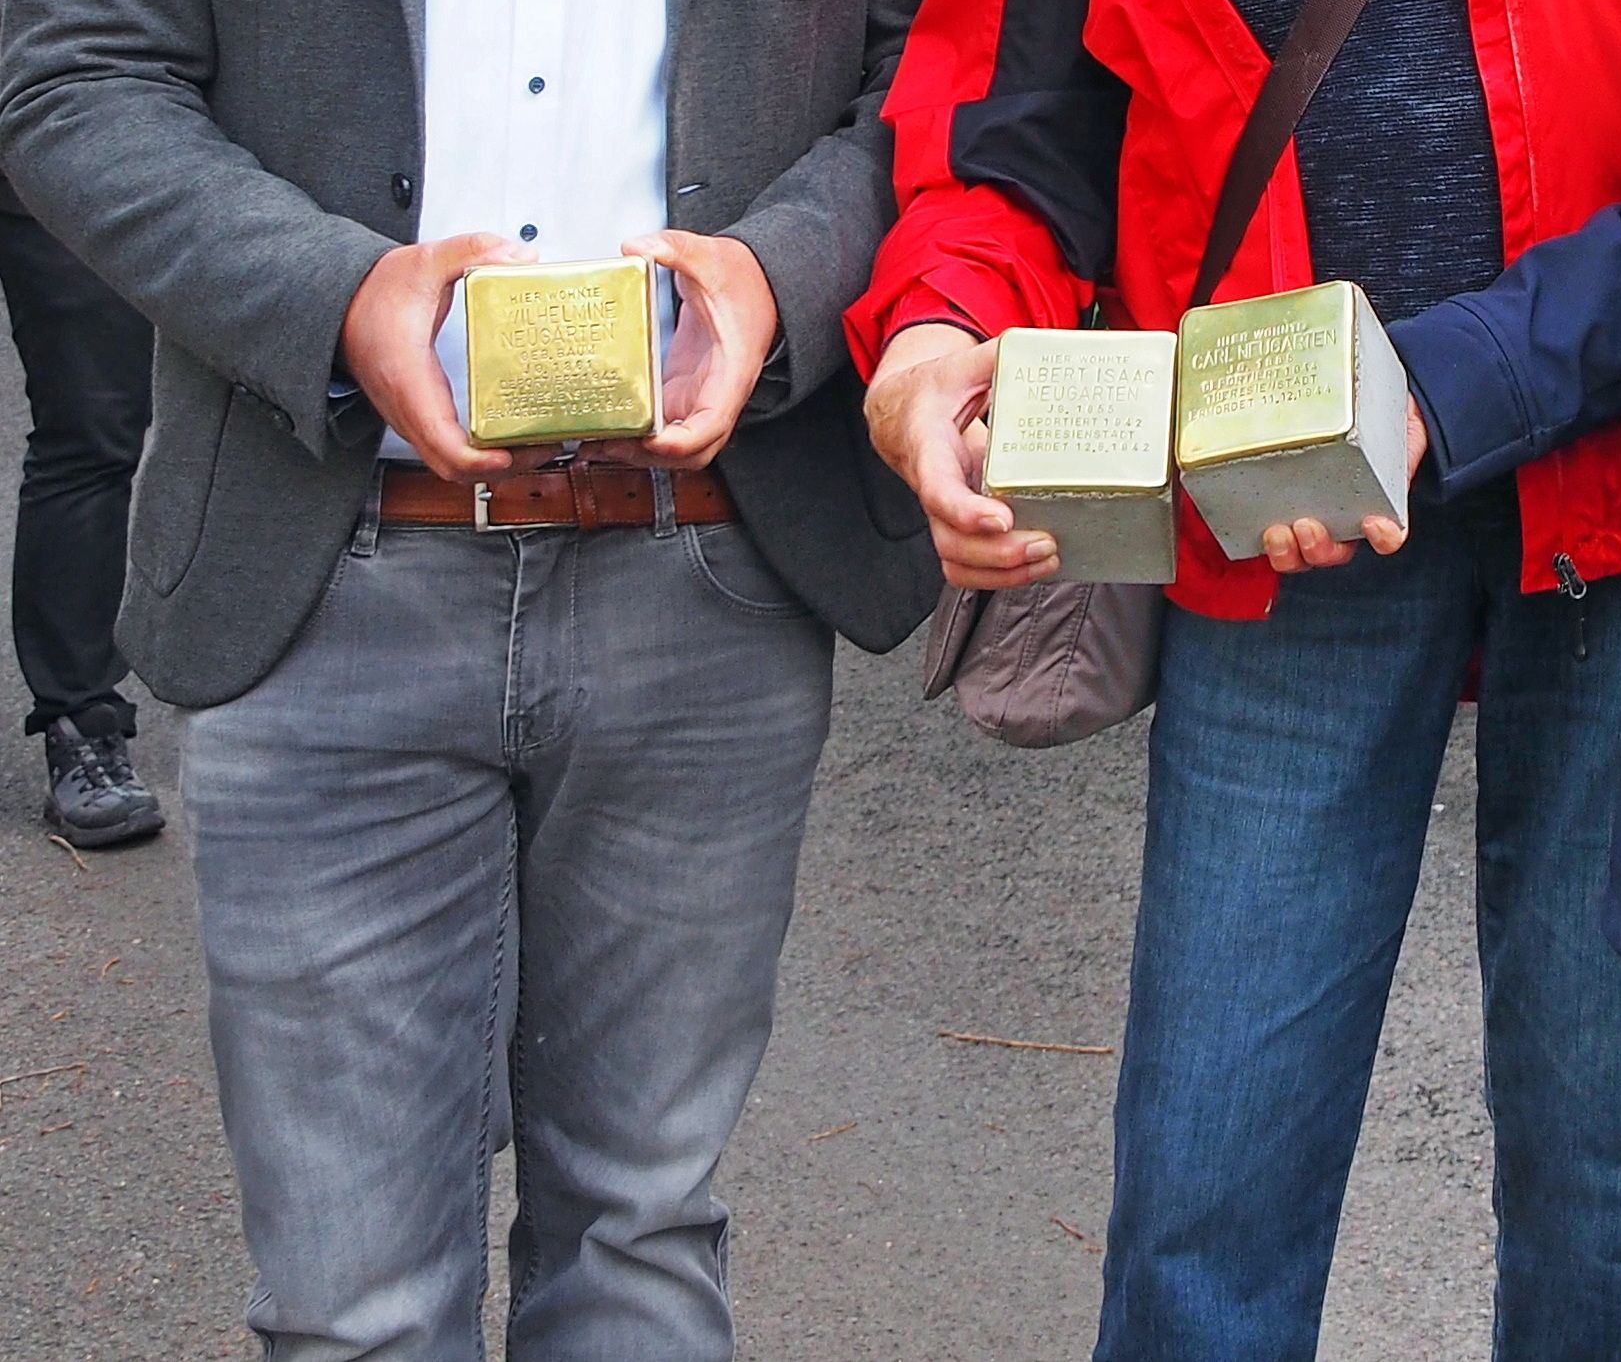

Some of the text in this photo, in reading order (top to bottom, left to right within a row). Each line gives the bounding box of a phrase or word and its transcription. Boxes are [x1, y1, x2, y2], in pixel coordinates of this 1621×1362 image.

[510, 286, 601, 304] HIER WOHNTE
[504, 300, 618, 326] WILHELMINE
[501, 322, 616, 349] NEUGARTEN
[557, 345, 595, 359] BAUM
[1192, 328, 1338, 371] CARL NEUGARTEN
[1042, 354, 1131, 365] HIER WOHNTE
[1014, 367, 1156, 385] ALBERT ISAAC
[1028, 385, 1141, 403] NEUGARTEN
[1047, 405, 1070, 416] JG.
[1018, 417, 1099, 428] DEPORTIERT
[1021, 429, 1137, 440] THERESIENSTADT
[1002, 442, 1070, 453] ERMORDET
